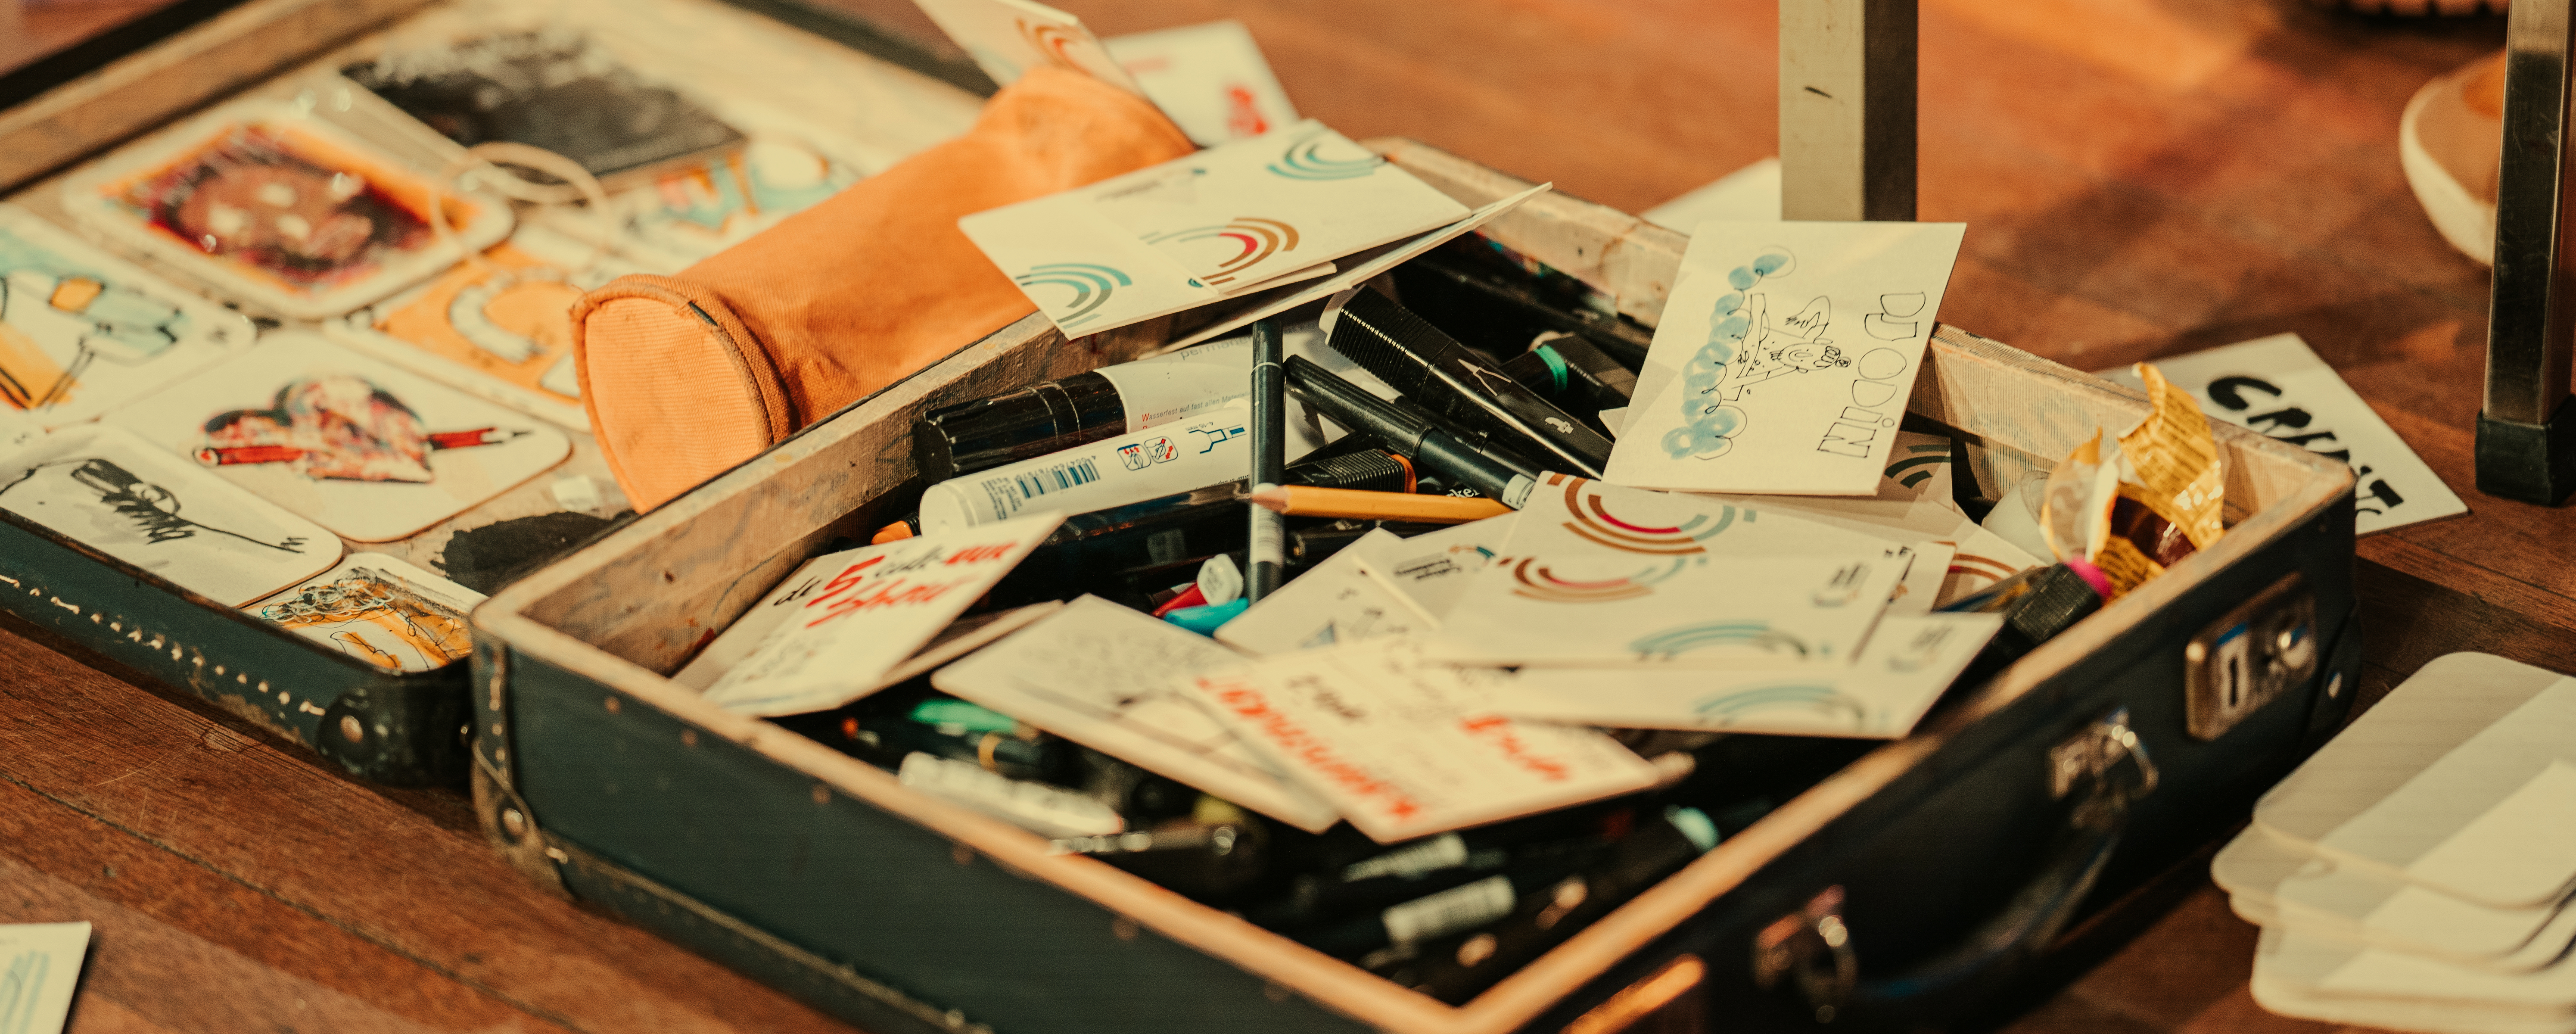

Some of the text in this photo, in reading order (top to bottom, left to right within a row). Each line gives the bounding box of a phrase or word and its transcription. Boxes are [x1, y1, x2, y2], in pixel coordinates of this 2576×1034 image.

[1864, 292, 1926, 341] DJ
[1180, 336, 1251, 361] permane
[1142, 408, 1177, 422] Wasserfest
[1179, 404, 1189, 413] auf
[1192, 402, 1203, 410] fast
[1205, 398, 1220, 407] allen
[805, 555, 886, 609] 5
